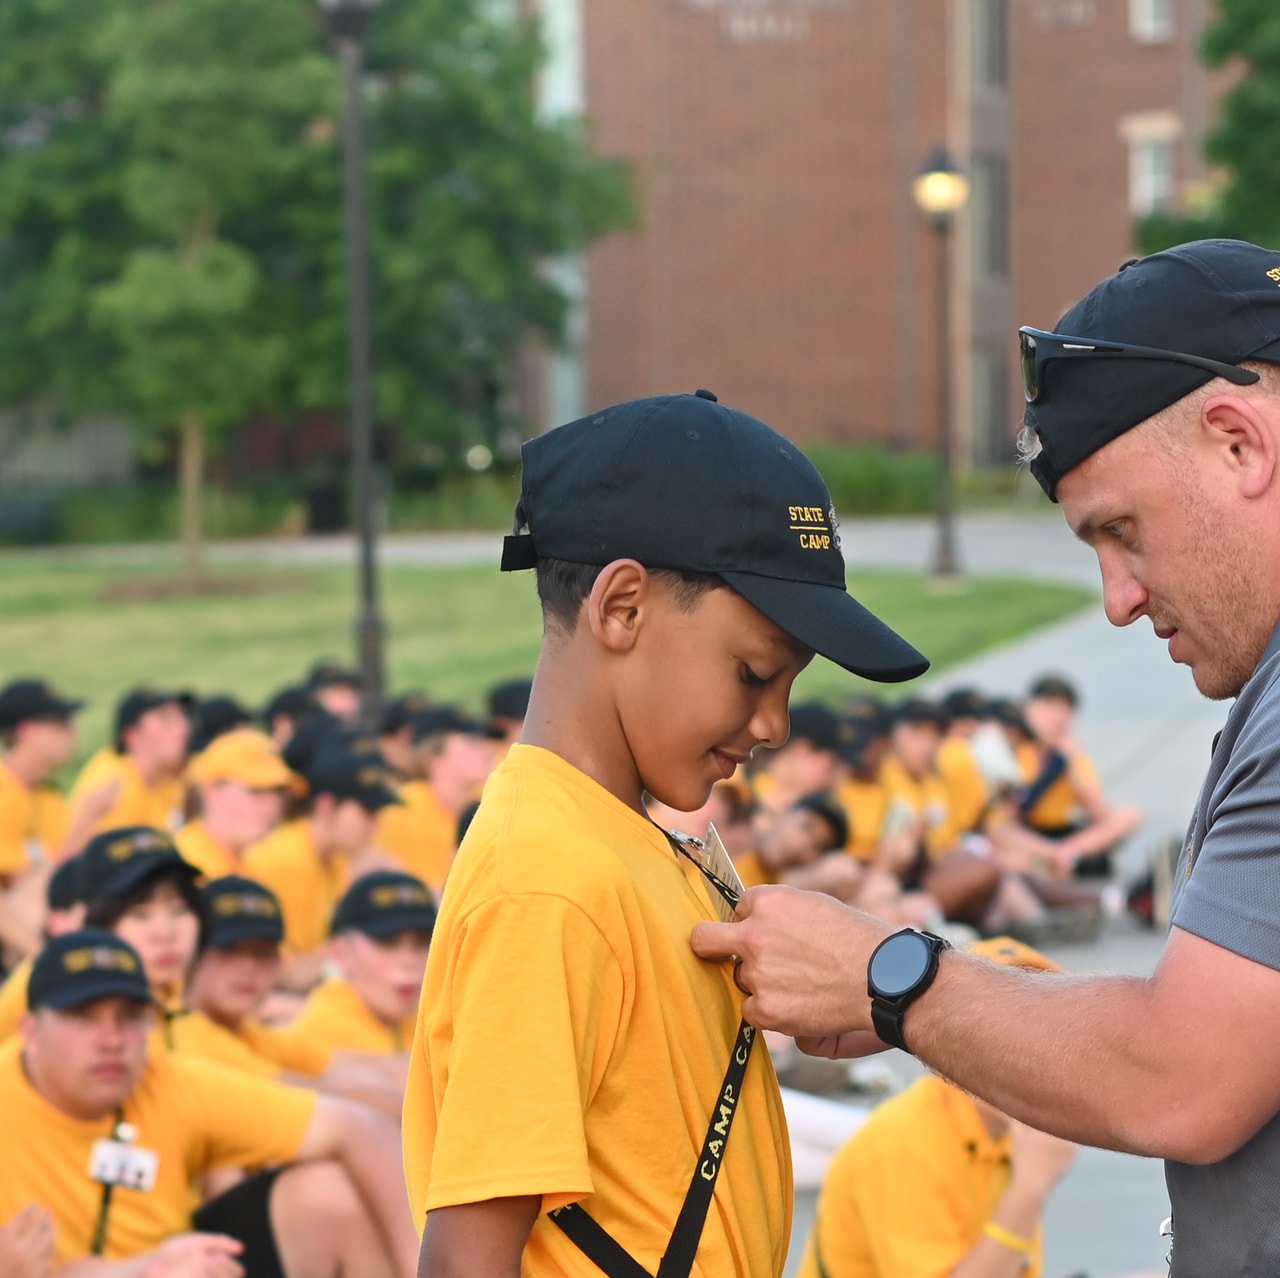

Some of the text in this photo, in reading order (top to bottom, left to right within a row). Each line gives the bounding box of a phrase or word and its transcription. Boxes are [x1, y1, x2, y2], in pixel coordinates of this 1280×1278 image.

[788, 506, 824, 522] STATE
[800, 534, 830, 550] CAMP
[700, 1083, 735, 1181] CAMP
